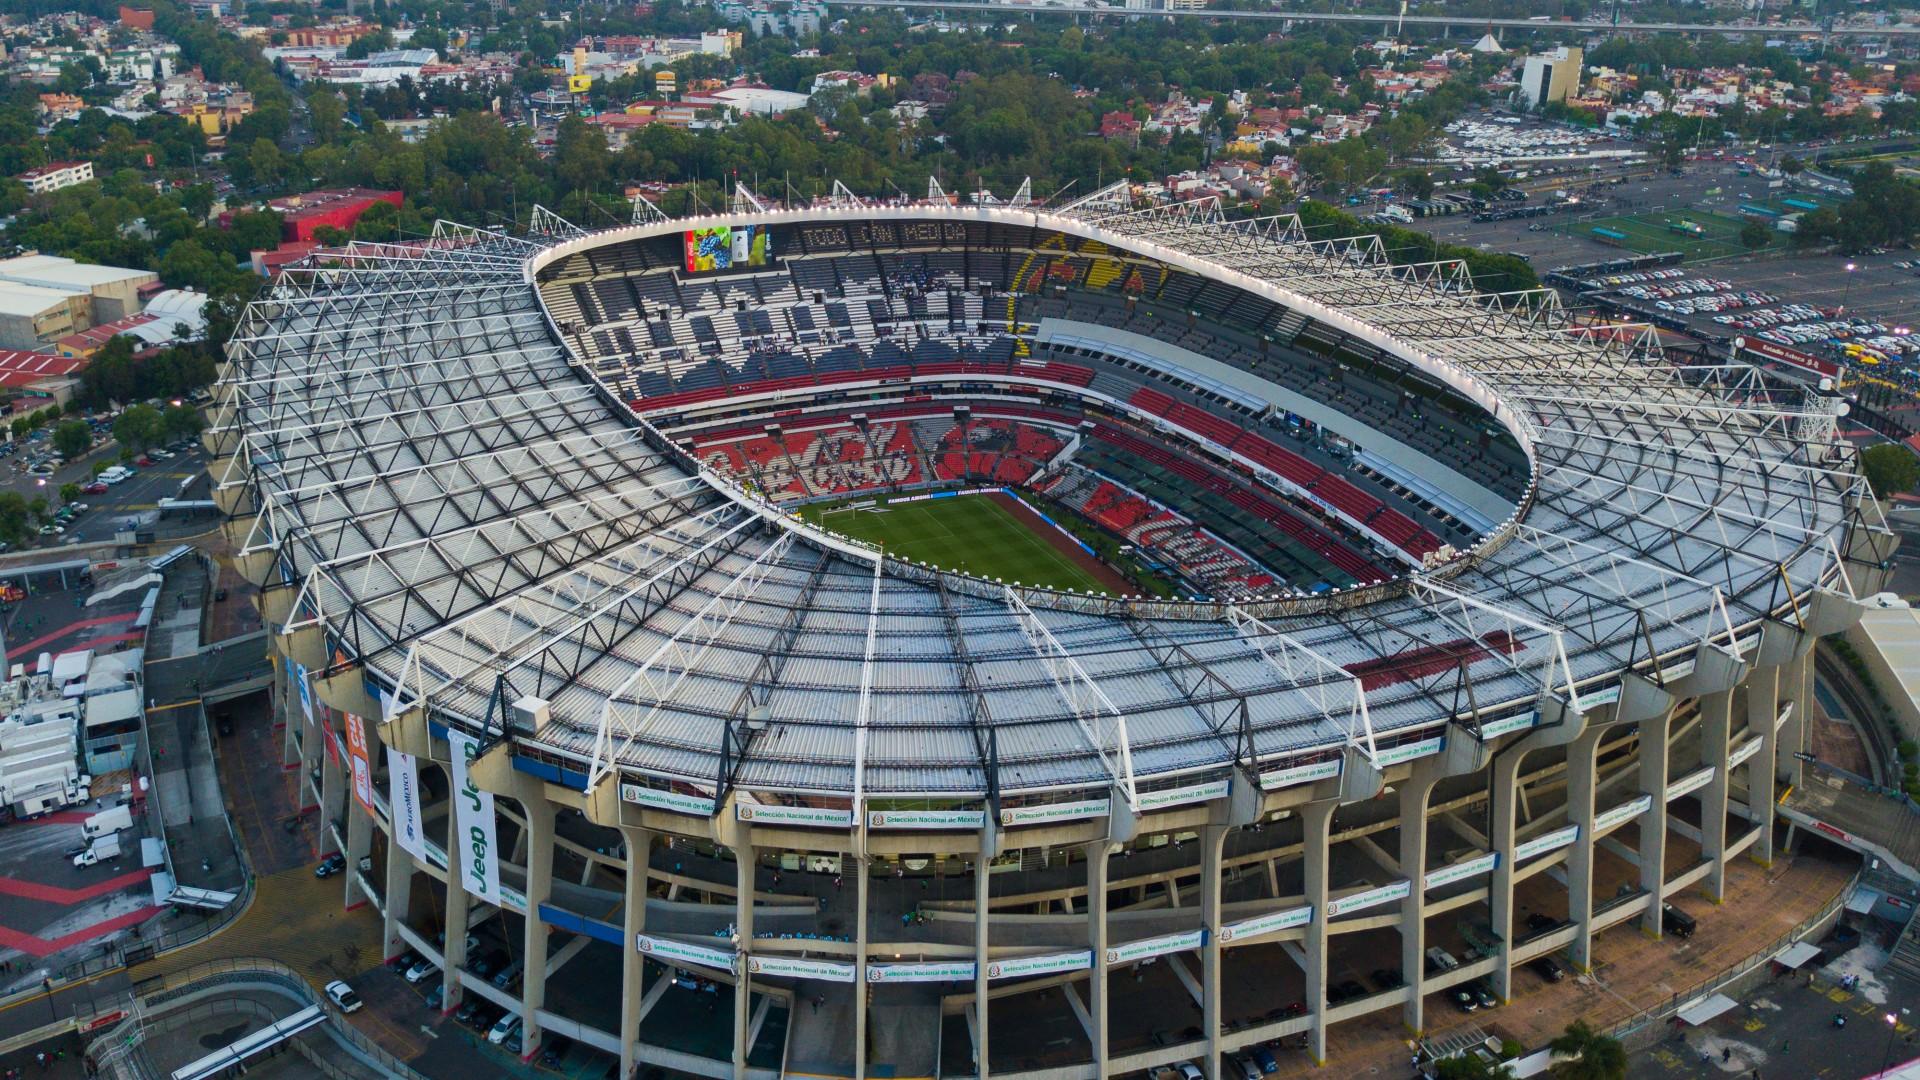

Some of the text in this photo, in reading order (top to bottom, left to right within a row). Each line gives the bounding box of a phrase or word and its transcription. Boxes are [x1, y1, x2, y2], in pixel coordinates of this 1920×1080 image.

[803, 228, 847, 245] TODO
[904, 223, 966, 240] MEDIDA
[461, 741, 482, 813] Jep
[638, 792, 666, 803] Selección
[666, 797, 692, 808] Nacional
[1170, 791, 1195, 802] Nacional
[755, 810, 785, 819] Selección
[786, 812, 814, 821] Nacional
[1046, 808, 1073, 817] Nacional
[886, 815, 917, 824] Selección
[957, 815, 981, 823] México
[470, 825, 488, 894] Jeep
[654, 944, 680, 954] Selección
[681, 948, 705, 959] Nacional
[762, 964, 791, 972] Selección
[792, 966, 819, 974] Nacional
[1032, 961, 1058, 970] Nacional
